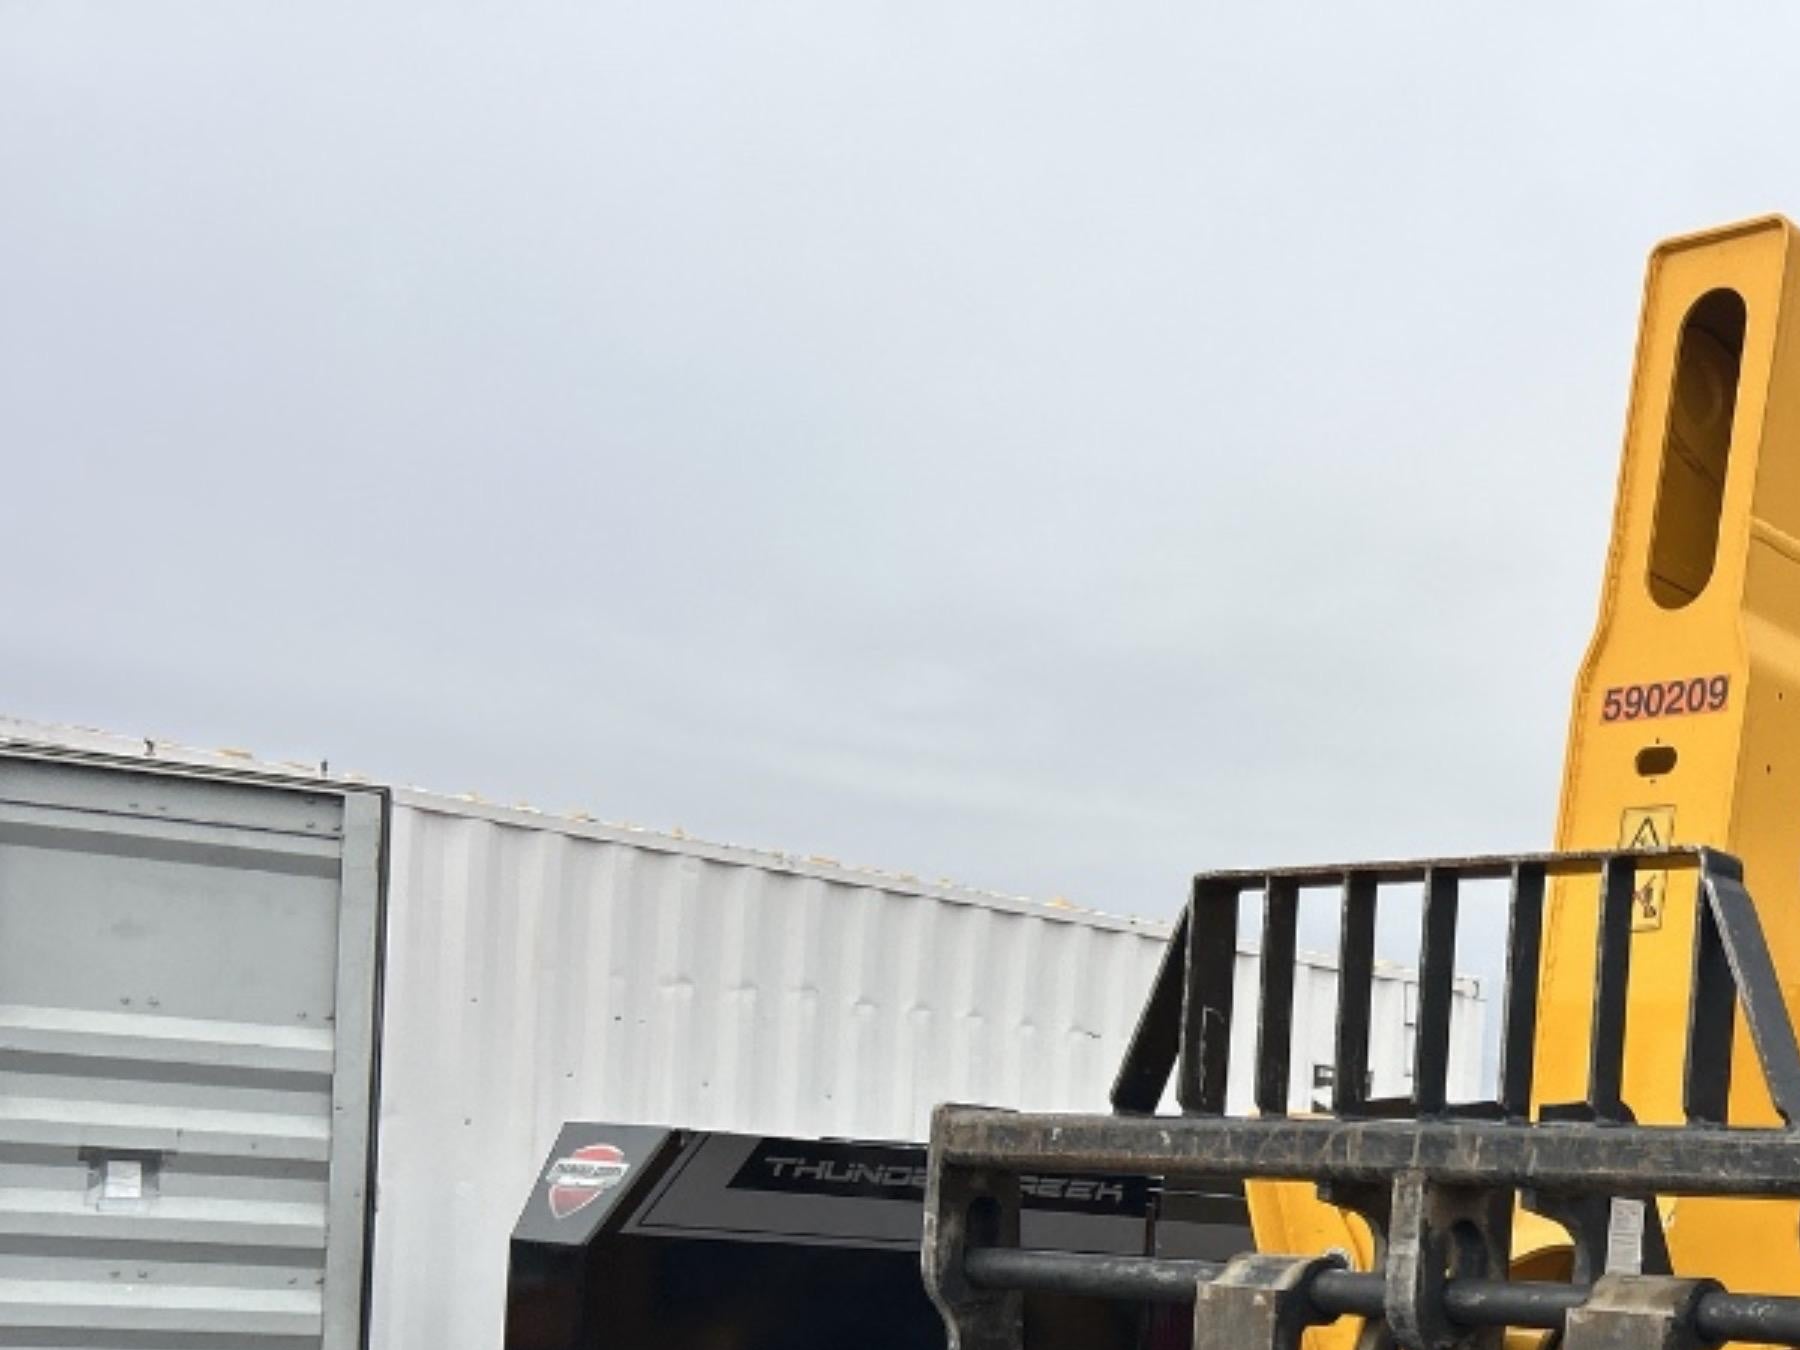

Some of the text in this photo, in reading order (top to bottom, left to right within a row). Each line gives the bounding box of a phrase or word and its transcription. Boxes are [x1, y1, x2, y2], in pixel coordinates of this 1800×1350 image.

[1602, 675, 1730, 722] 590209
[764, 1156, 1123, 1204] THUNDE REEK
